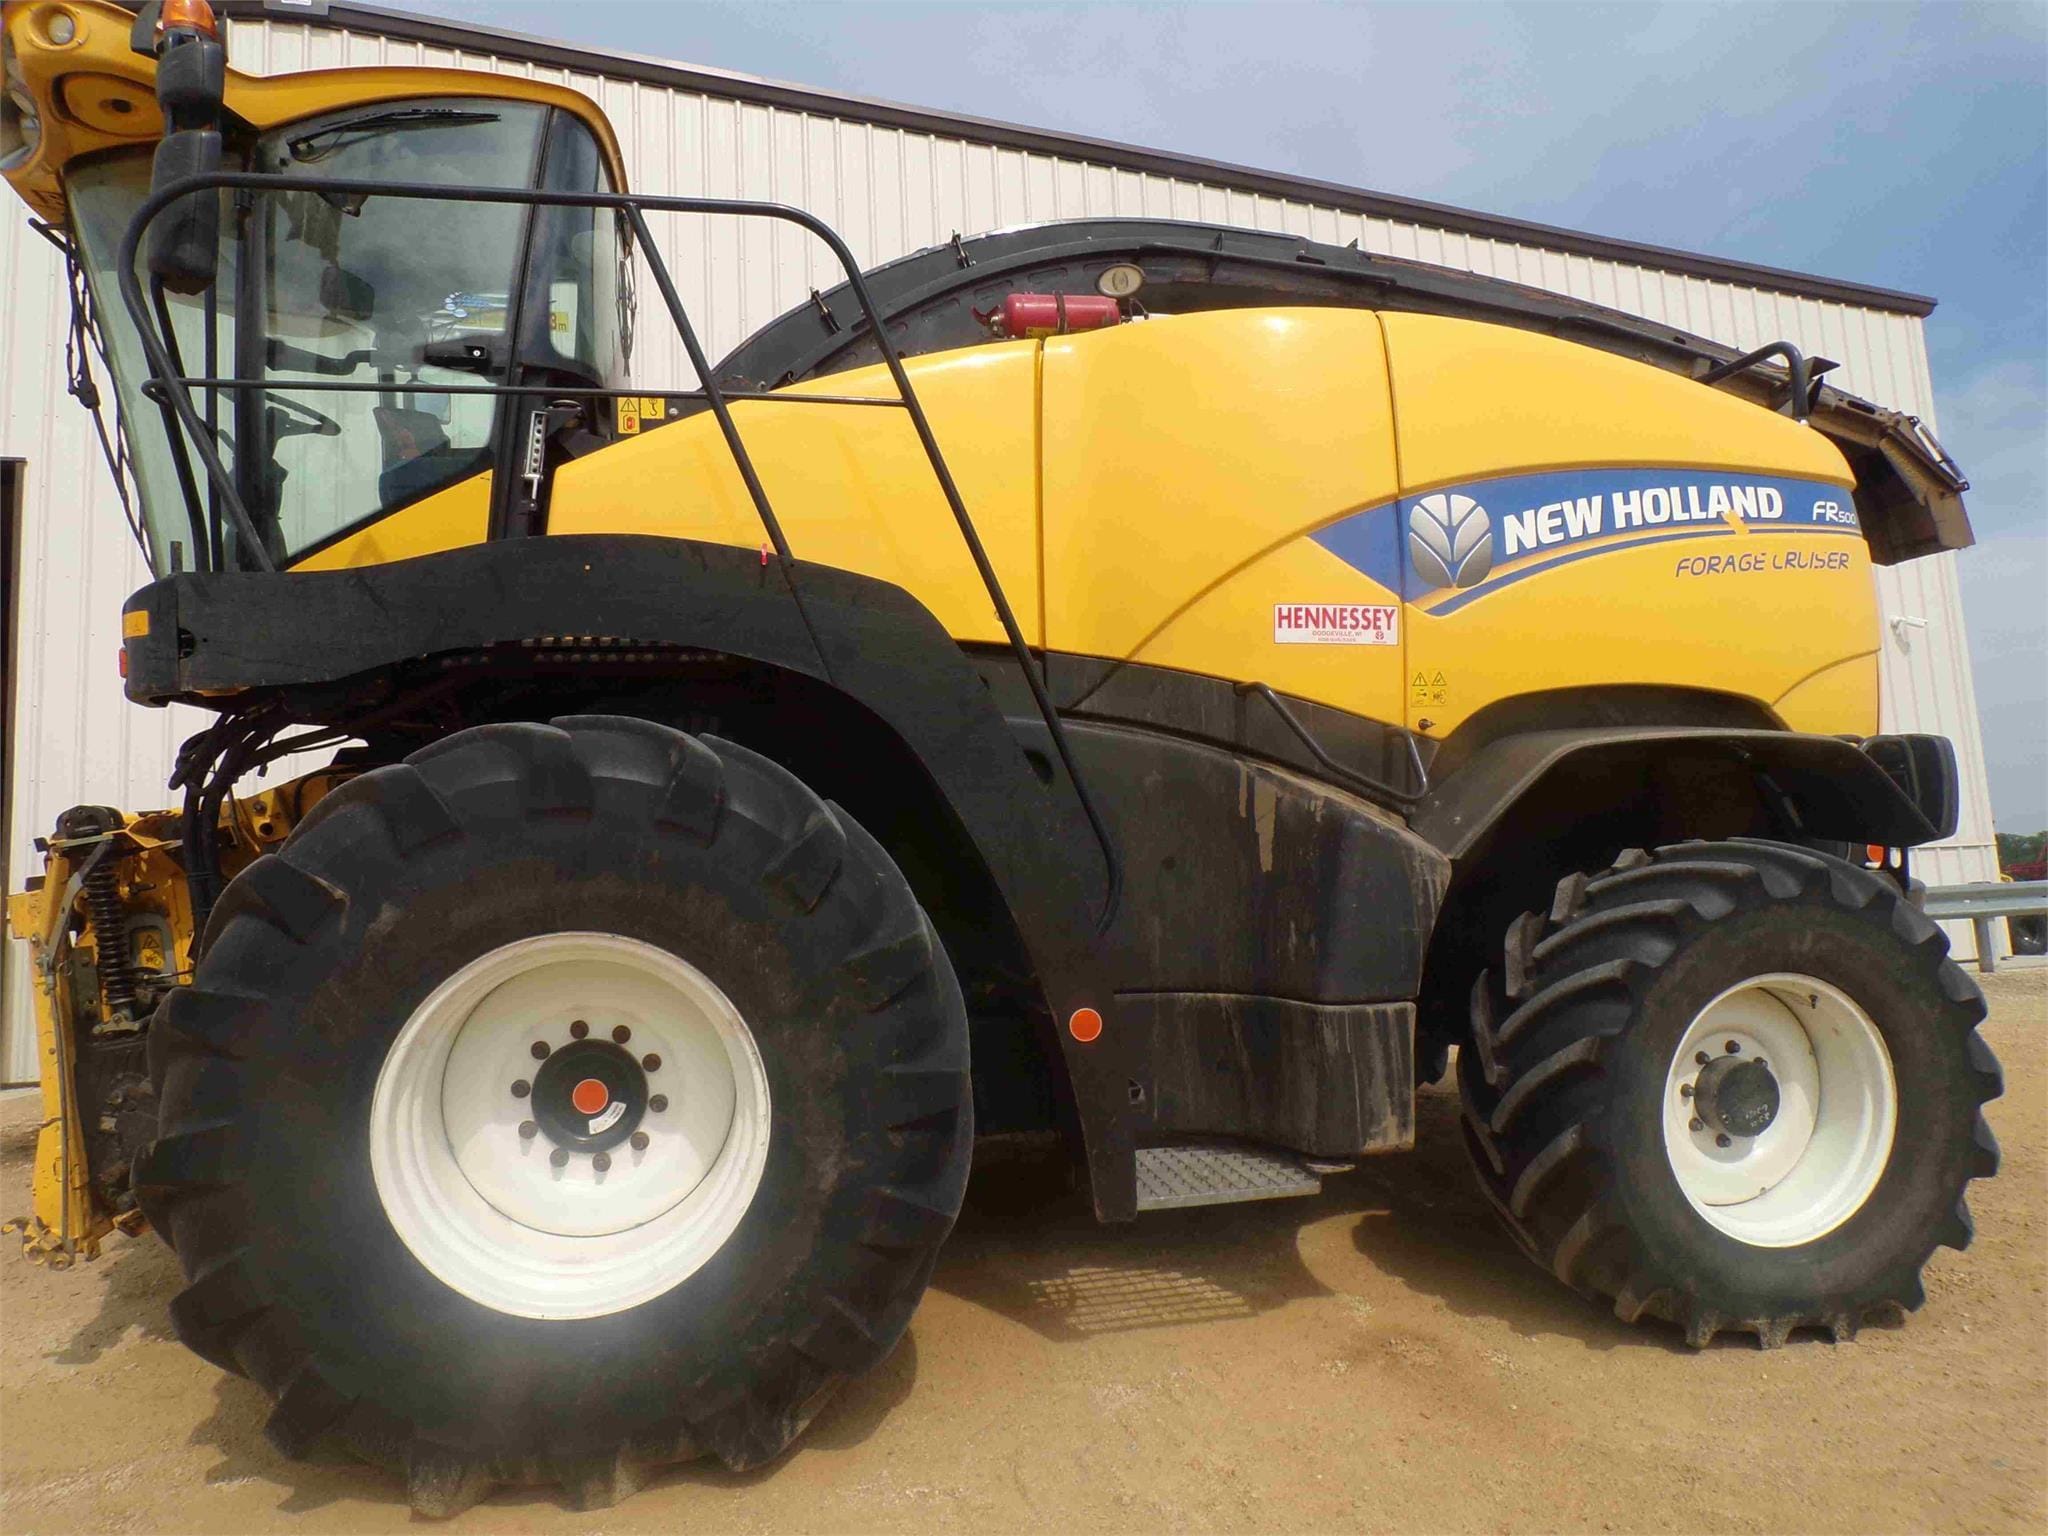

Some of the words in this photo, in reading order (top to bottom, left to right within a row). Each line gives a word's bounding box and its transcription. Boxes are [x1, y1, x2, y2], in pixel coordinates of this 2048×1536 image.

[1503, 495, 1602, 555] NEW
[1612, 485, 1783, 529] HOLLAND
[1813, 501, 1856, 525] FR500
[1676, 553, 1767, 578] FORAGE
[1277, 607, 1396, 631] HENNESSEY
